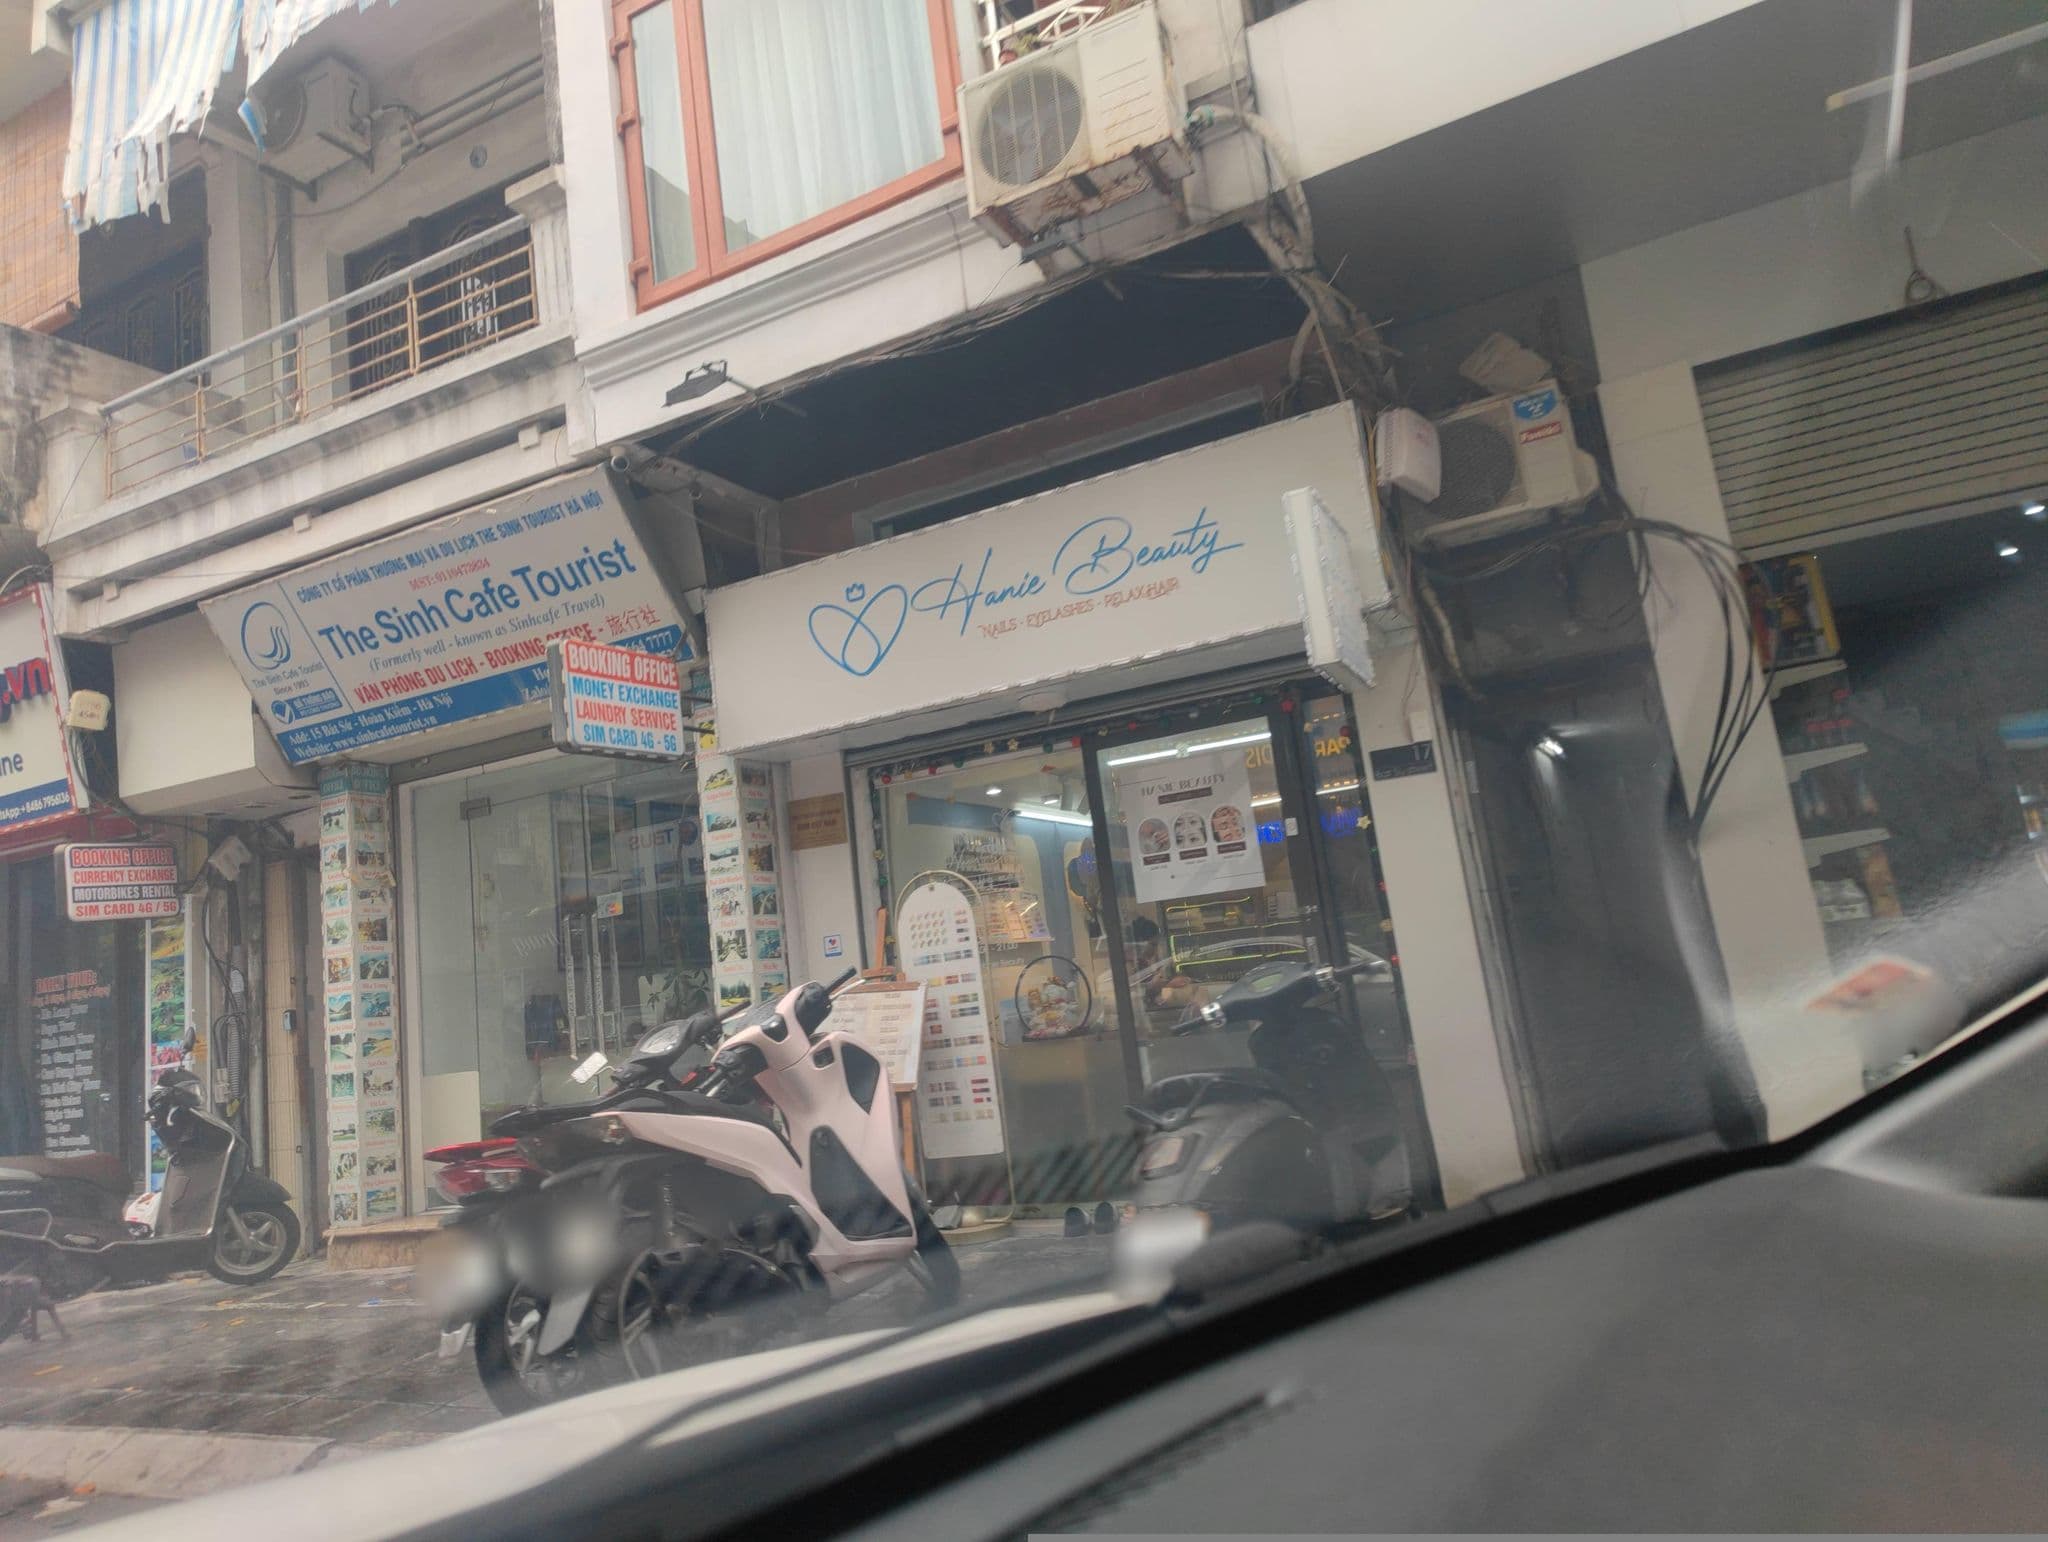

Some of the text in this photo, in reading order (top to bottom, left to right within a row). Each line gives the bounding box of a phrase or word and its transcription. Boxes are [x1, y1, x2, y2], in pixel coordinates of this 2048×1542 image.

[319, 581, 332, 595] TY
[476, 527, 497, 543] THE
[494, 516, 523, 537] SINH
[521, 504, 565, 528] TOURIST
[564, 499, 583, 514] HÀ
[911, 507, 1244, 636] Hanie Beauty
[318, 538, 636, 659] The Sinh Cafe Tourist
[369, 648, 421, 671] (Formerly
[423, 639, 446, 656] well
[454, 630, 492, 647] known
[495, 626, 507, 636] as
[508, 608, 560, 632] Sinhcafe
[561, 593, 605, 616] Travel)
[605, 604, 661, 635] 旅行社
[646, 630, 673, 649] 7777
[354, 683, 383, 704] VĂN
[380, 671, 427, 697] PHÒNG
[424, 664, 446, 684] DU
[444, 656, 478, 681] LỊCH
[484, 636, 547, 668] BOOKING
[568, 644, 631, 678] BOOKING
[634, 656, 677, 686] OFFICE
[572, 676, 678, 709] MONEY EXCHANGE
[576, 700, 677, 731] LAUNDRY SERVICE
[289, 731, 311, 744] Add:
[310, 727, 322, 739] 15
[294, 743, 333, 757] Website:
[584, 724, 605, 743] SIM
[609, 727, 637, 746] CARD
[641, 731, 654, 749] 4G
[664, 734, 676, 751] 5G
[71, 848, 130, 867] BOOKING
[74, 868, 175, 884] CURRENCY EXCHANGE
[74, 884, 176, 902] MOTORBIKES RENTAL
[76, 905, 99, 917] SIM
[103, 903, 134, 916] CARD
[138, 903, 152, 913] 4G
[163, 901, 176, 912] 5G
